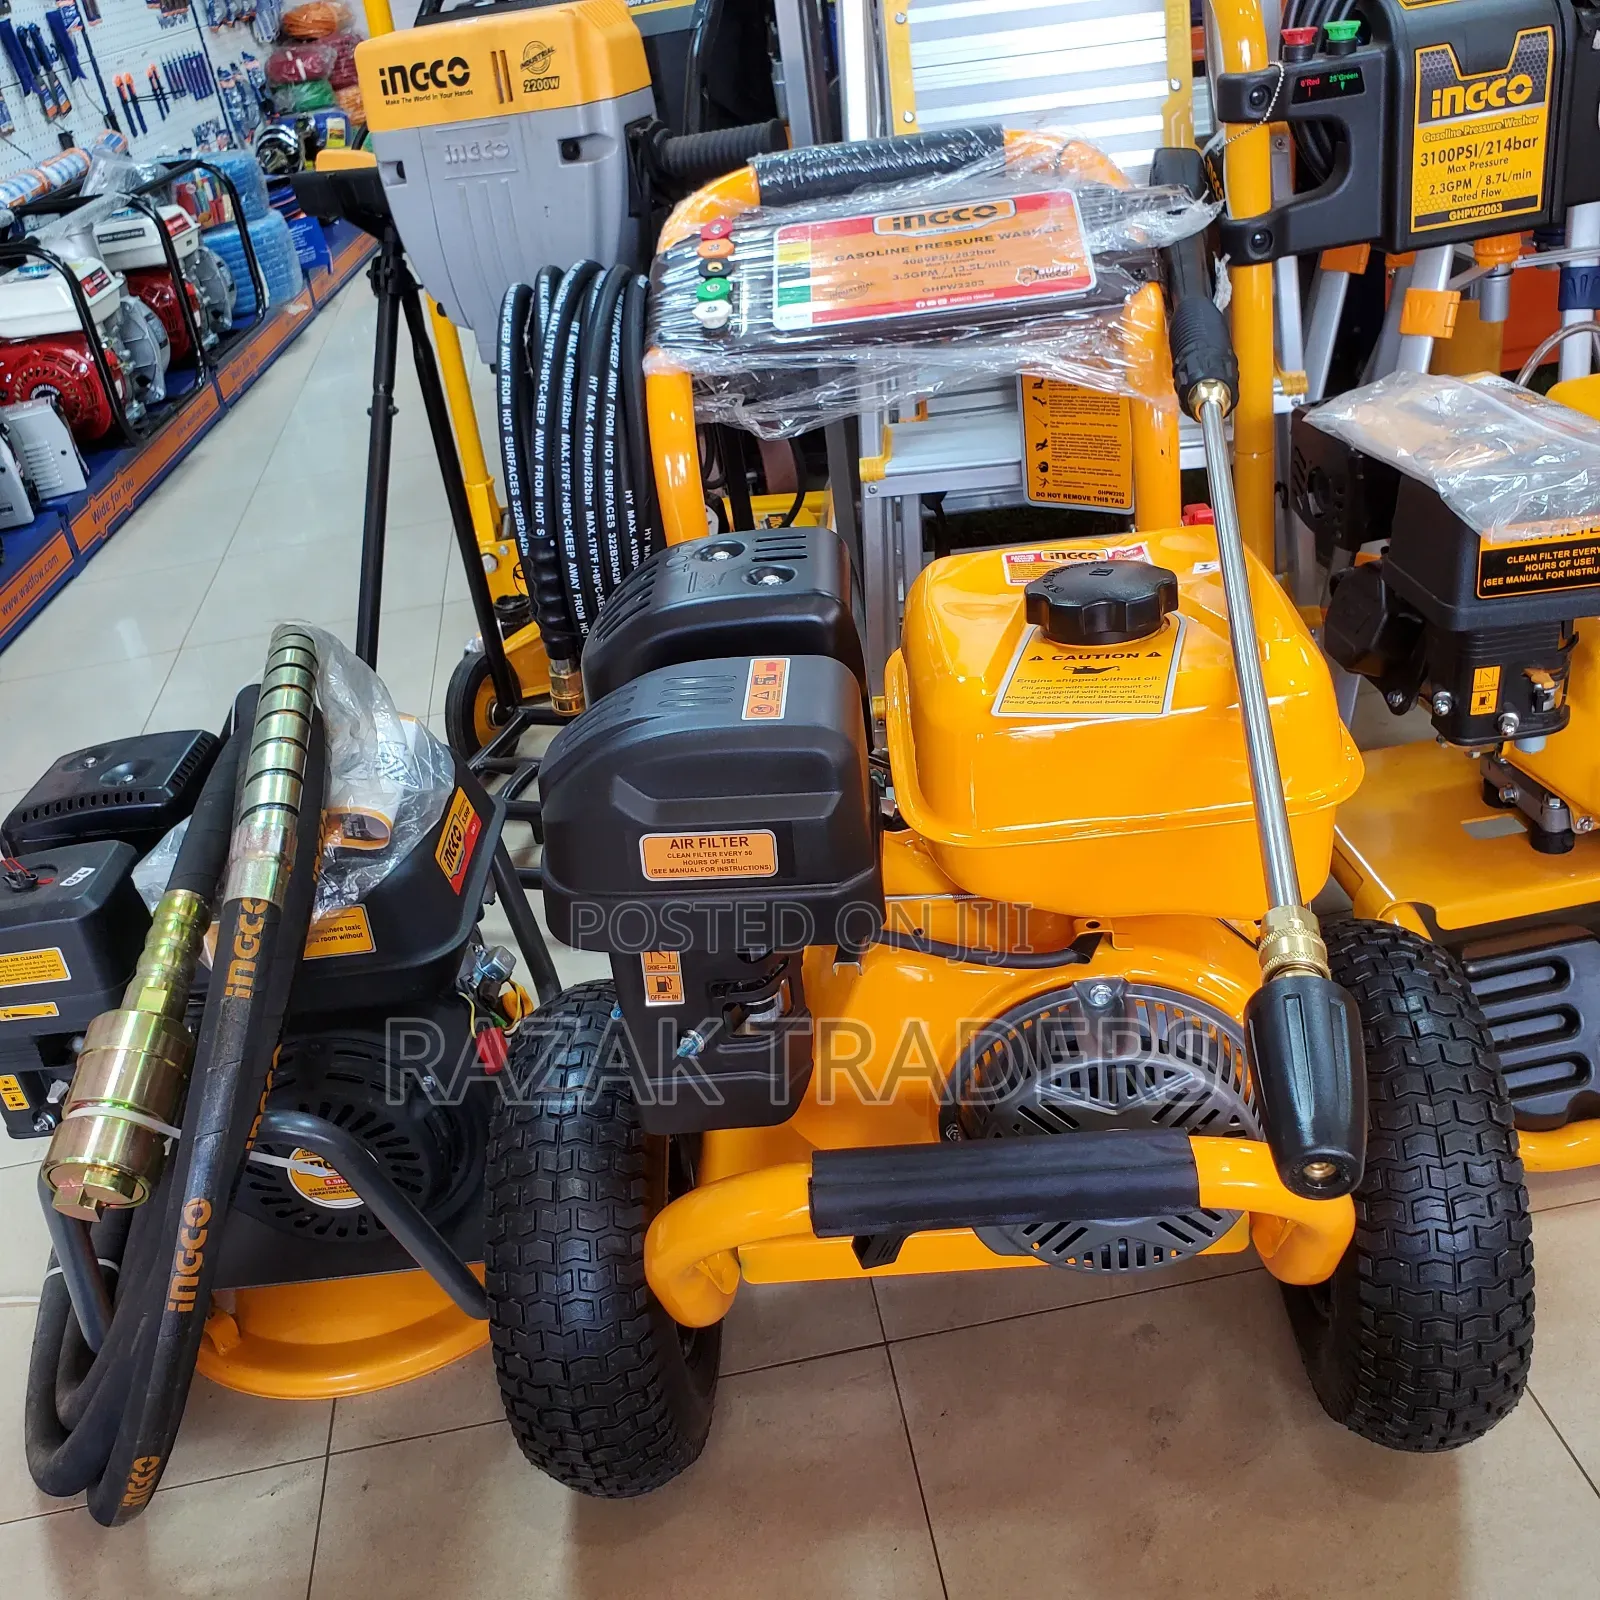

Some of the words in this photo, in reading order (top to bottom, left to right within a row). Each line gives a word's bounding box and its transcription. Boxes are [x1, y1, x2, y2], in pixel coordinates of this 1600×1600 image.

[524, 76, 560, 93] 2200W
[1422, 129, 1462, 143] Gasoline
[1463, 121, 1503, 137] Pressure
[1503, 115, 1539, 128] Washer
[1420, 136, 1539, 167] 3100PSI/214bar
[1447, 164, 1466, 175] Max
[1469, 157, 1509, 171] Pressure
[1429, 178, 1472, 195] 2.3GPM
[1485, 168, 1532, 186] 8.7L/min
[1452, 190, 1478, 203] Rated
[1481, 188, 1502, 199] Flow
[1448, 203, 1503, 221] GHPW2003
[834, 246, 910, 262] GASOLINE
[915, 235, 994, 252] PRESSURE
[501, 374, 511, 405] FROM
[588, 375, 599, 392] HY
[606, 369, 618, 401] AWAY
[502, 408, 513, 433] HOT
[605, 403, 615, 436] FROM
[535, 428, 545, 461] AWAY
[604, 440, 614, 465] HOT
[504, 436, 520, 496] SURFACES
[534, 465, 544, 497] FROM
[91, 501, 111, 525] Wide
[110, 490, 122, 511] for
[121, 476, 135, 492] You
[604, 469, 616, 529] SURFACES
[624, 490, 633, 505] HY
[1063, 493, 1091, 501] REMOVE
[1093, 495, 1109, 503] THIS
[1110, 497, 1124, 505] TAG
[535, 501, 545, 525] HOT
[644, 527, 652, 541] HY
[1506, 553, 1538, 565] CLEAN
[1539, 549, 1570, 560] FILTER
[1525, 561, 1557, 572] HOURS
[1558, 560, 1572, 568] OF
[1573, 557, 1595, 566] USE!
[567, 562, 581, 590] AWAY
[1483, 577, 1504, 588] (SEE
[1506, 574, 1544, 584] MANUAL
[1545, 571, 1564, 580] FOR
[572, 593, 586, 620] FROM
[1051, 653, 1140, 661] CAUTION
[670, 838, 694, 849] AIR
[699, 836, 749, 848] FILTER
[717, 864, 772, 872] INSTRUCTIONS)
[339, 931, 364, 940] without
[344, 923, 362, 931] toxic
